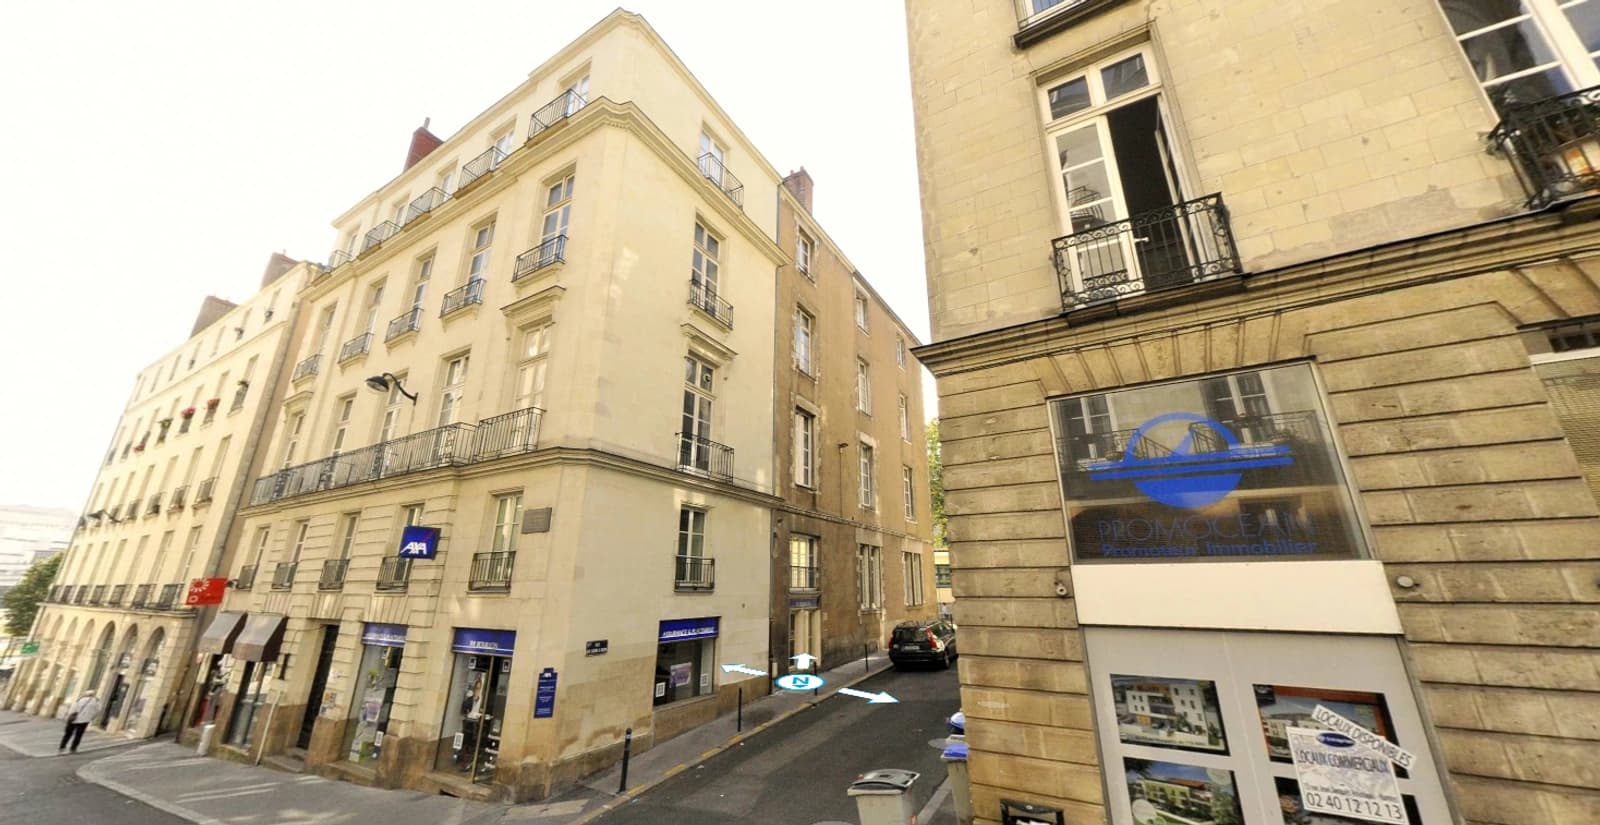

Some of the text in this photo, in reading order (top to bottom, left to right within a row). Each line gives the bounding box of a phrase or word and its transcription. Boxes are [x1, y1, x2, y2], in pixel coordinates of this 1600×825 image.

[1098, 513, 1316, 542] PROMOCEAN
[400, 541, 428, 555] AXA
[1102, 539, 1317, 558] Promoteur Immobilier
[1316, 711, 1412, 767] LOCAUX DISPONIBLES
[1298, 750, 1391, 773] LOCAUX COMMERCIAUX
[1306, 792, 1324, 808] 02
[1325, 795, 1342, 810] 40
[1344, 797, 1362, 813] 12
[1364, 801, 1382, 816] 12
[1384, 804, 1402, 819] 13
